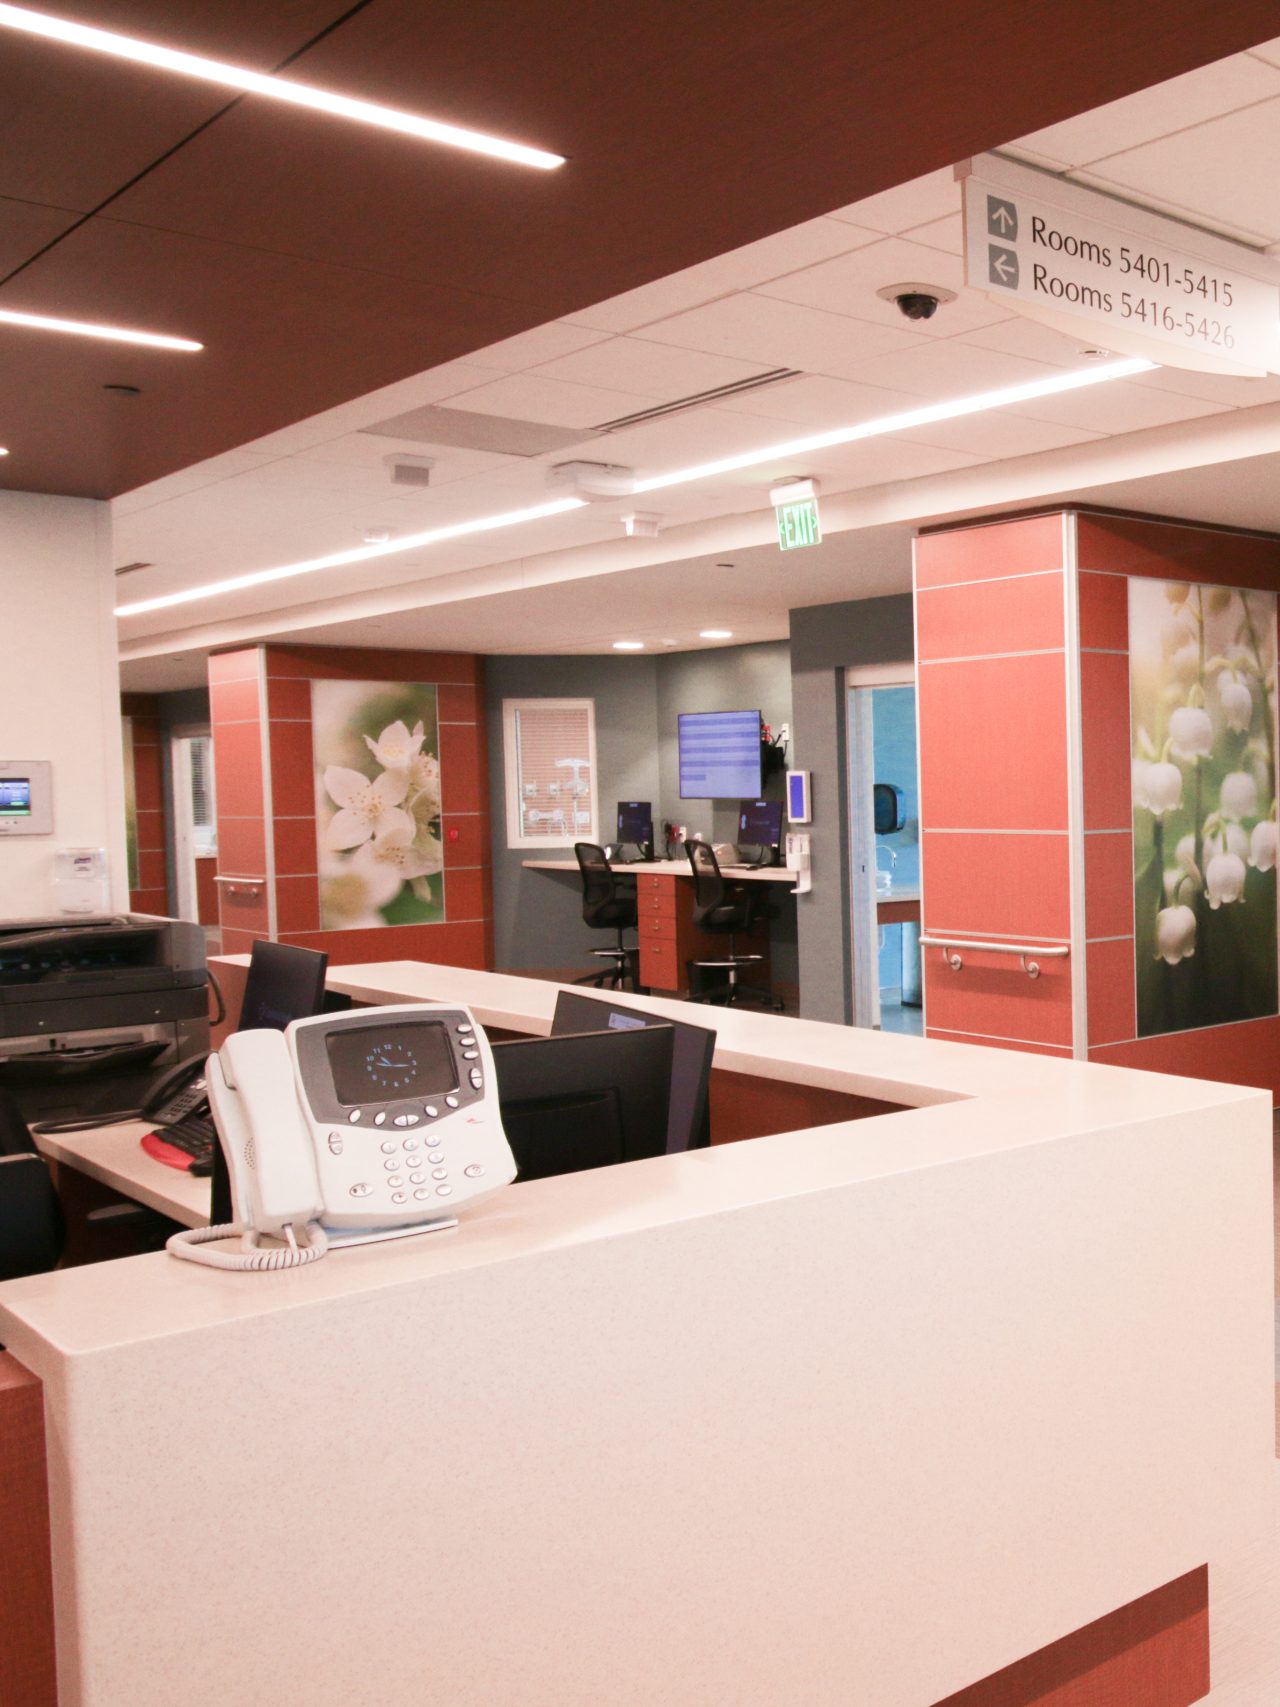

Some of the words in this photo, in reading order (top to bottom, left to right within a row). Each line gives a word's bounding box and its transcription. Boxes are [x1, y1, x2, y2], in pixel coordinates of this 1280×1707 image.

[1032, 216, 1112, 267] Rooms
[1119, 247, 1234, 307] 5401-5415
[1033, 263, 1113, 313] Rooms
[1120, 292, 1235, 349] 5416-5426
[783, 503, 814, 547] EXIT
